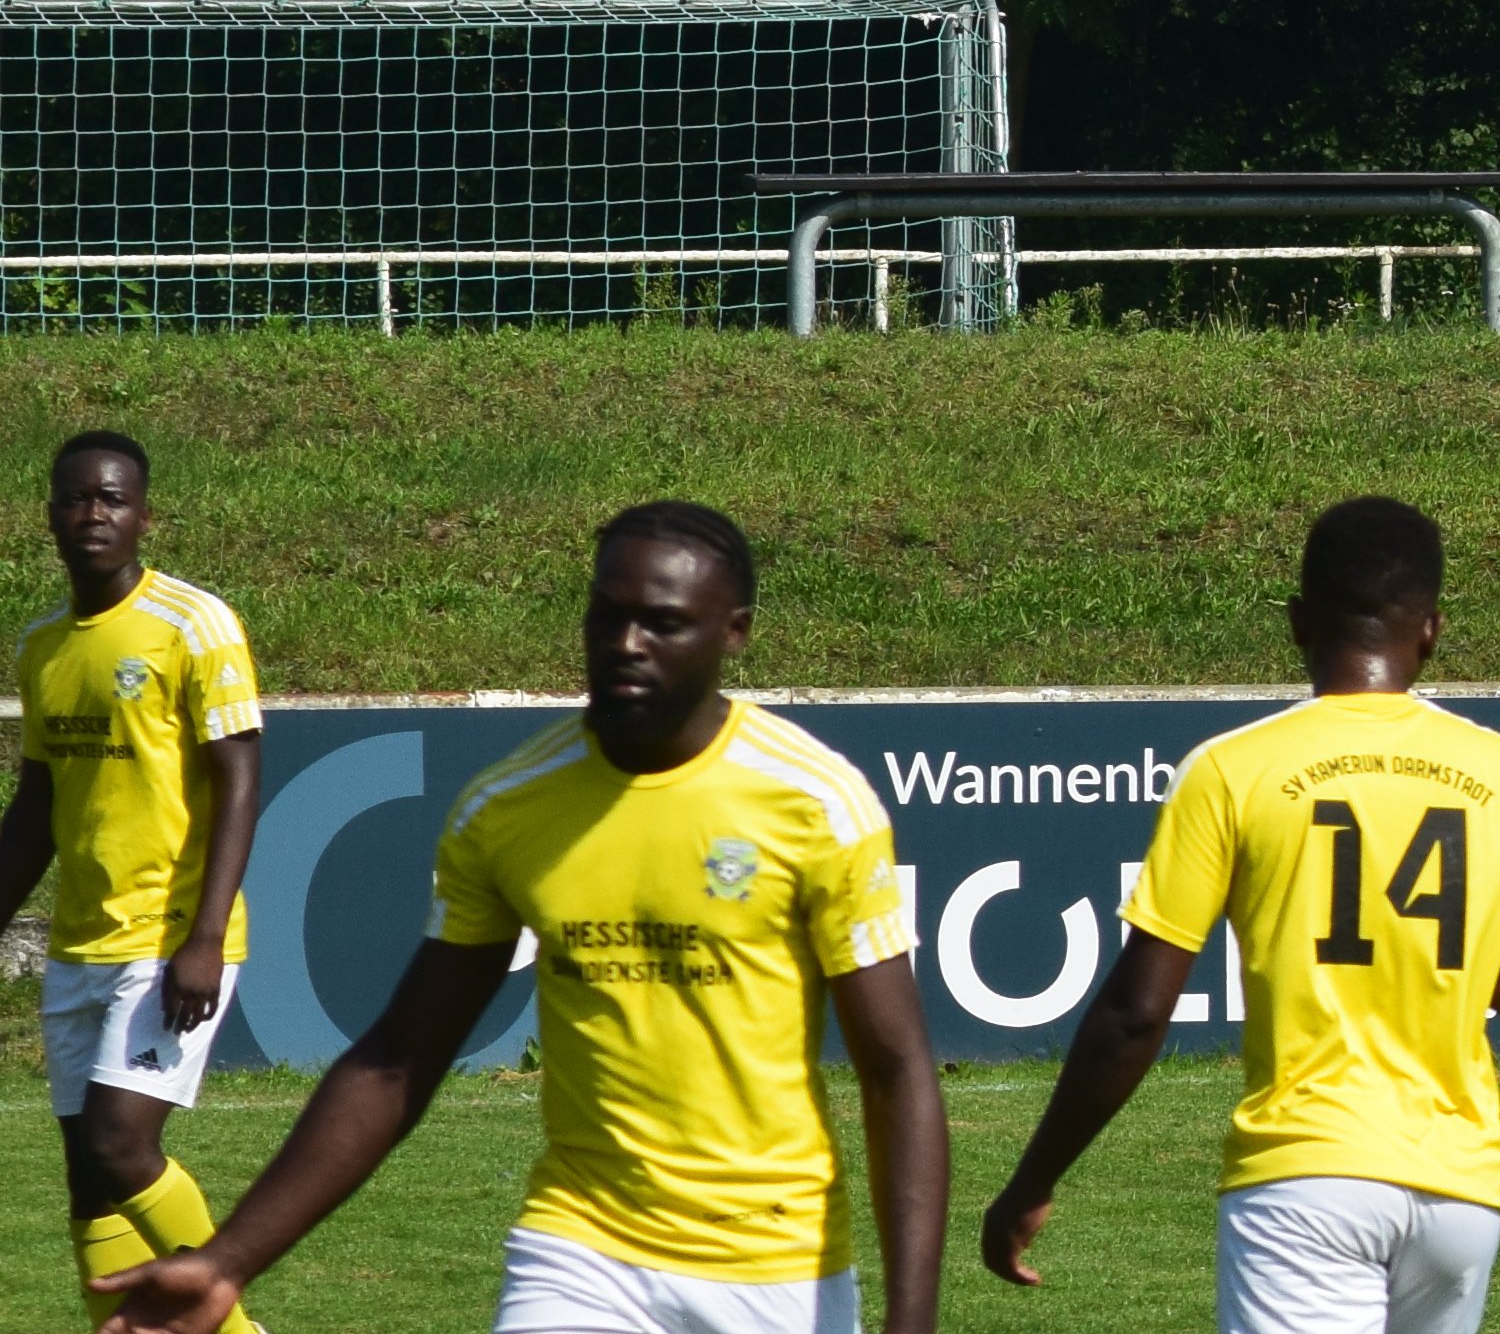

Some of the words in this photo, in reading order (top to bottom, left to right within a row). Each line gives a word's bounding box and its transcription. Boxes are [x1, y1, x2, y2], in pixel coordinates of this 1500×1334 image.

[884, 748, 1177, 805] Wannenb
[1281, 775, 1306, 801] SV
[1304, 755, 1386, 786] KAMERUN
[1391, 756, 1496, 808] DARMSTADT
[1311, 798, 1468, 971] 14
